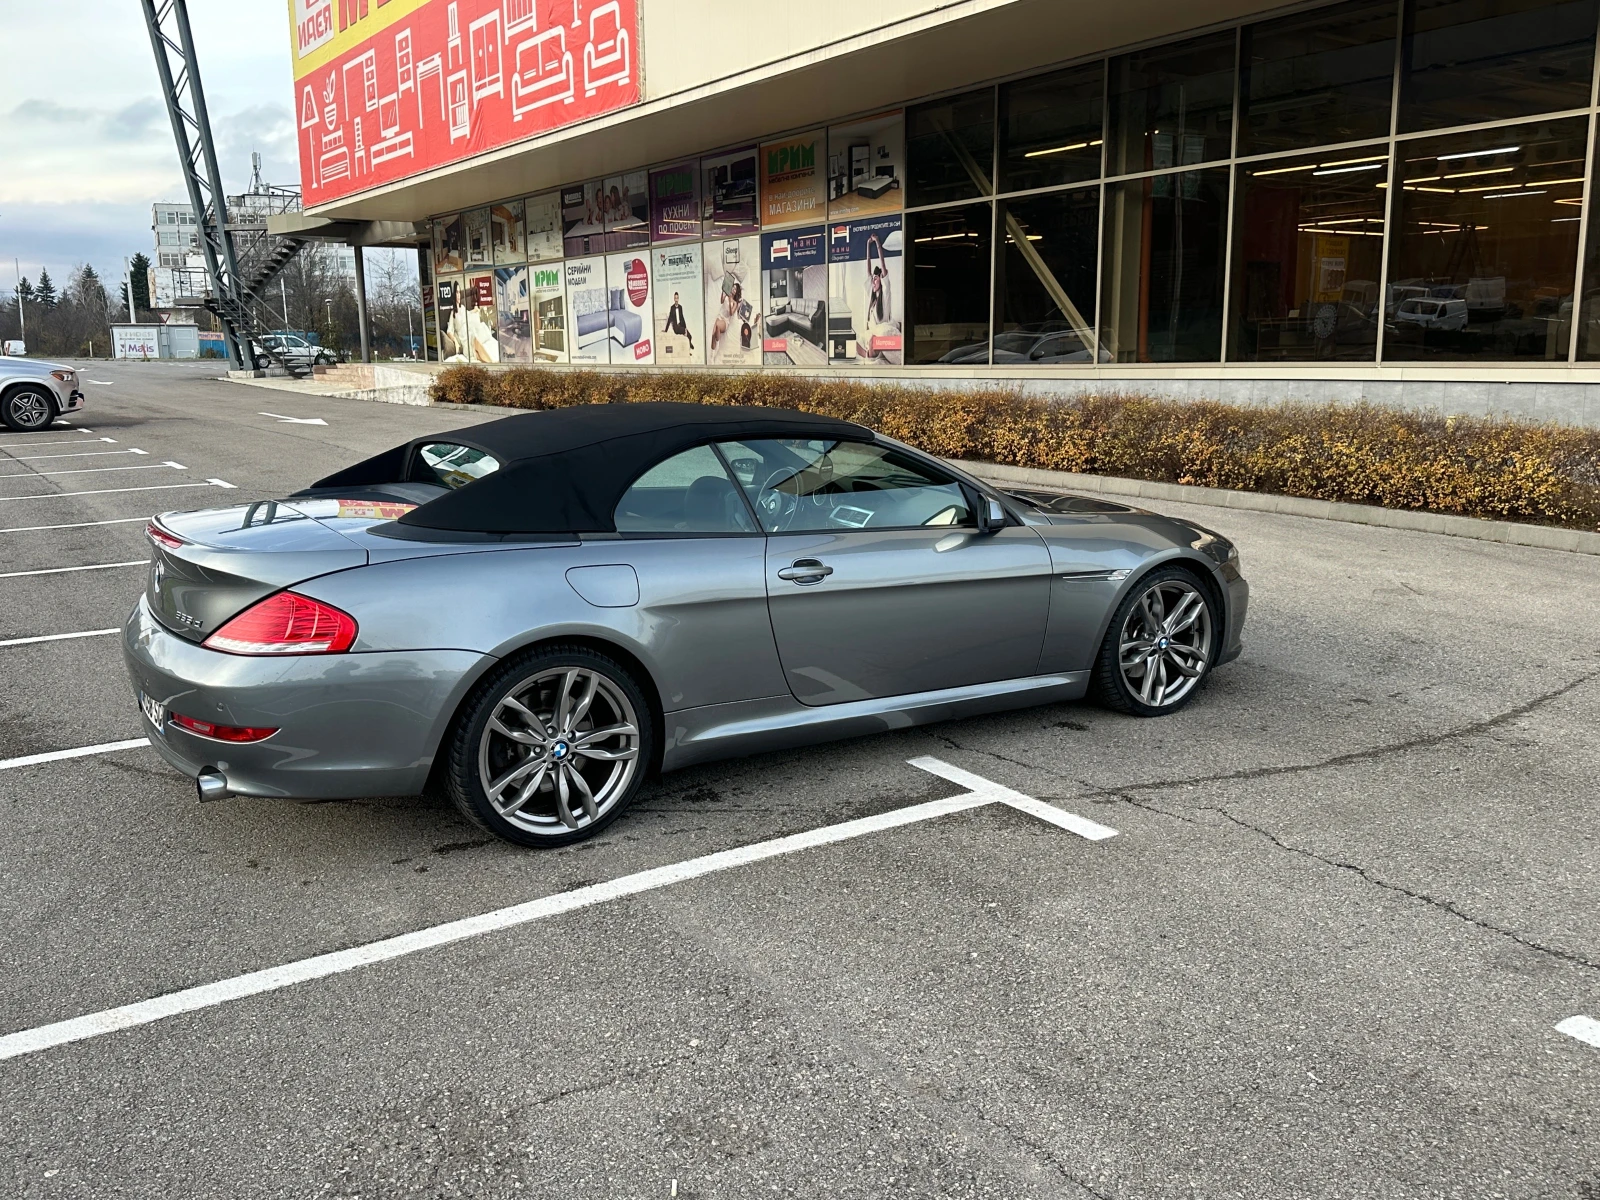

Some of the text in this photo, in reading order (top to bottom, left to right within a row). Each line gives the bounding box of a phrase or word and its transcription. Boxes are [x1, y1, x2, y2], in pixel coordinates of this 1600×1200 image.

[297, 3, 333, 51] ИДЕЯ
[768, 141, 815, 174] ИРИМ
[657, 172, 693, 198] ИРИМ
[662, 203, 690, 220] КУХНИ
[769, 196, 816, 216] МАГАЗИНИ
[658, 219, 696, 234] по проект
[567, 262, 591, 276] СЕРИЙНИ
[534, 269, 559, 288] ИРИМ
[567, 276, 587, 286] МОДЕЛИ
[635, 343, 650, 356] НОВО
